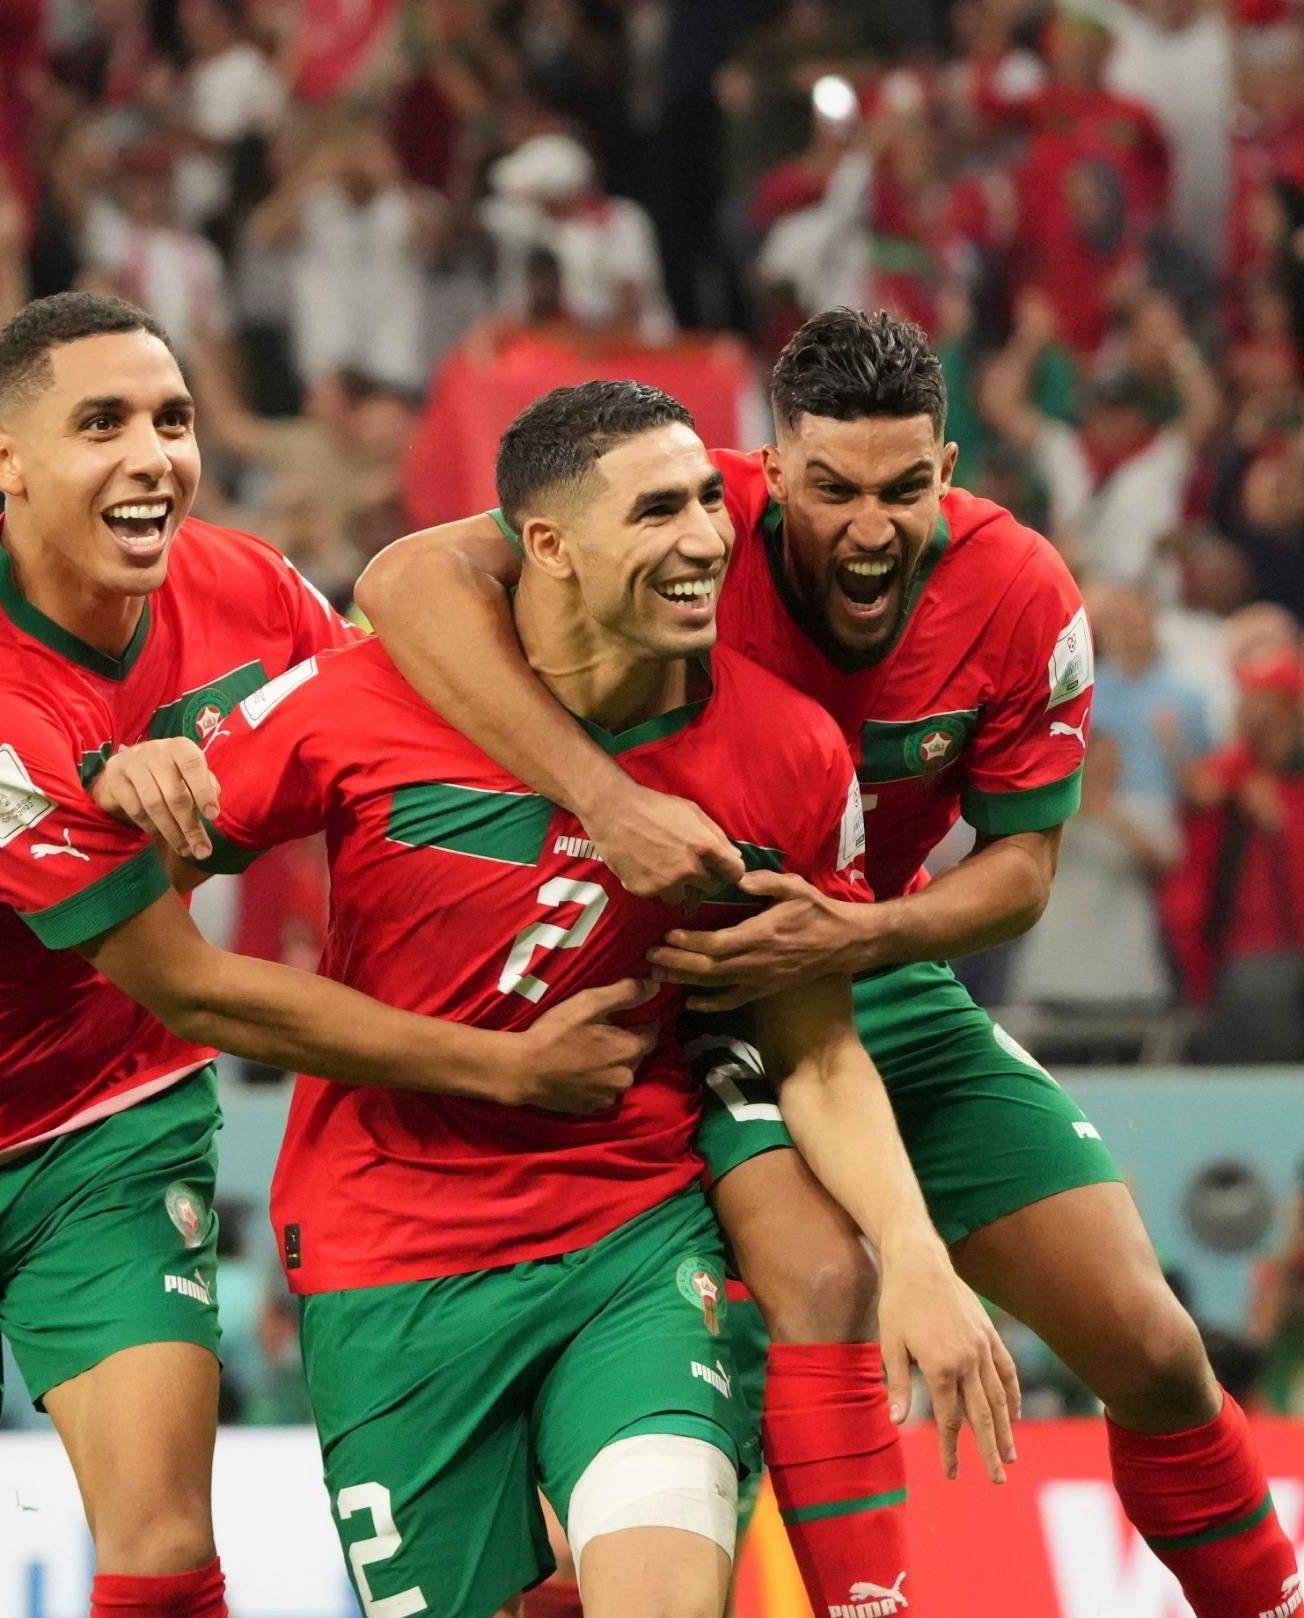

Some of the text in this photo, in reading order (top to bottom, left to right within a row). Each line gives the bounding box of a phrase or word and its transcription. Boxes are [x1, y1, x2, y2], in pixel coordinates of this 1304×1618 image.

[553, 836, 603, 862] PUM
[498, 877, 609, 1004] 2
[164, 1274, 210, 1305] PUMA
[337, 1482, 428, 1618] 2
